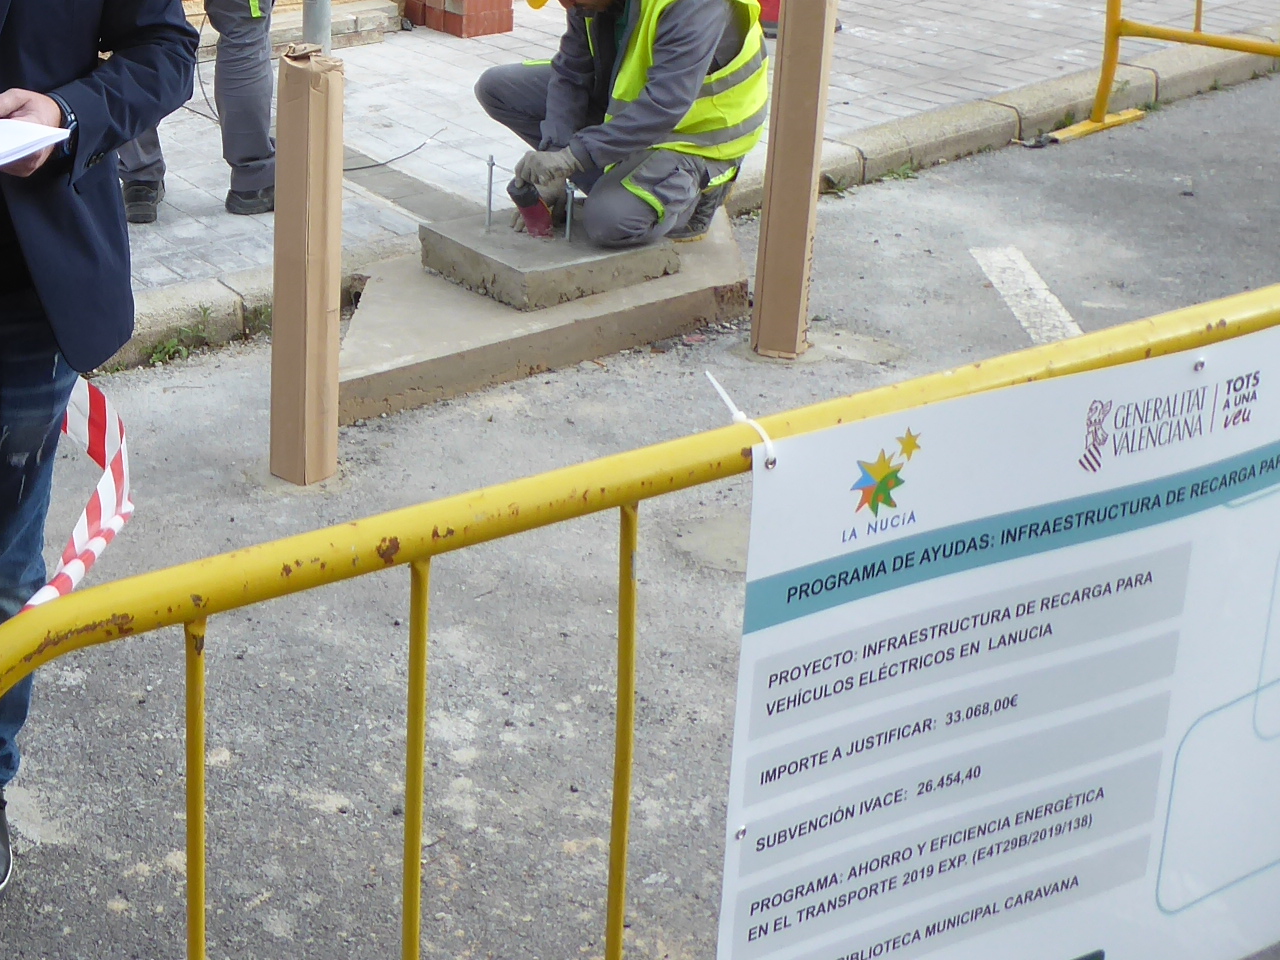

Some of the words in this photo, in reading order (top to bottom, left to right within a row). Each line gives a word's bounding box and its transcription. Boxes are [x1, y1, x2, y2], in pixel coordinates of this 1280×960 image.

[1113, 385, 1208, 430] GENERALITAT
[1223, 398, 1231, 412] A
[1234, 390, 1258, 407] UNA
[1223, 407, 1251, 429] veu
[1226, 370, 1260, 396] TOTS
[1112, 414, 1203, 457] VALENCIANA
[786, 559, 887, 604] PROGRAMA
[892, 551, 916, 572] DE
[918, 533, 995, 566] AYUDAS:
[1000, 494, 1161, 546] INFRAESTRUCTURA
[1165, 485, 1186, 506] DE
[1189, 464, 1256, 499] RECARGA
[841, 526, 858, 543] LA
[766, 676, 855, 716] VEHÍCULOS
[859, 647, 955, 687] ELÉCTRICOS
[960, 640, 981, 658] EN
[988, 623, 1053, 651] LANUCIA
[767, 649, 859, 689] PROYECTO:
[862, 606, 1011, 660] INFRAESTRUCTURA
[1015, 600, 1036, 618] DE
[1040, 581, 1112, 612] RECARGA
[1115, 571, 1153, 592] PARA
[760, 750, 829, 786] IMPORTE
[831, 746, 842, 762] A
[846, 718, 938, 757] JUSTIFICAR:
[945, 693, 1019, 727] 33.068,00€
[749, 872, 844, 917] PROGRAMA:
[847, 847, 913, 881] AHORRO
[917, 841, 927, 857] Y
[930, 816, 1011, 853] EFICIENCIA
[1015, 786, 1105, 826] ENERGÉTICA
[755, 804, 855, 852] SUBVENCIÓN
[859, 788, 908, 816] IVACE:
[917, 765, 982, 796] 26.454,40
[748, 922, 769, 942] EN
[773, 916, 792, 933] EL
[796, 875, 898, 923] TRANSPORTE
[902, 864, 935, 887] 2019
[938, 852, 968, 874] EXP.
[836, 929, 921, 960] BLIOTECA
[924, 902, 1000, 939] MUNICIPAL
[1004, 875, 1079, 910] CARAVANA
